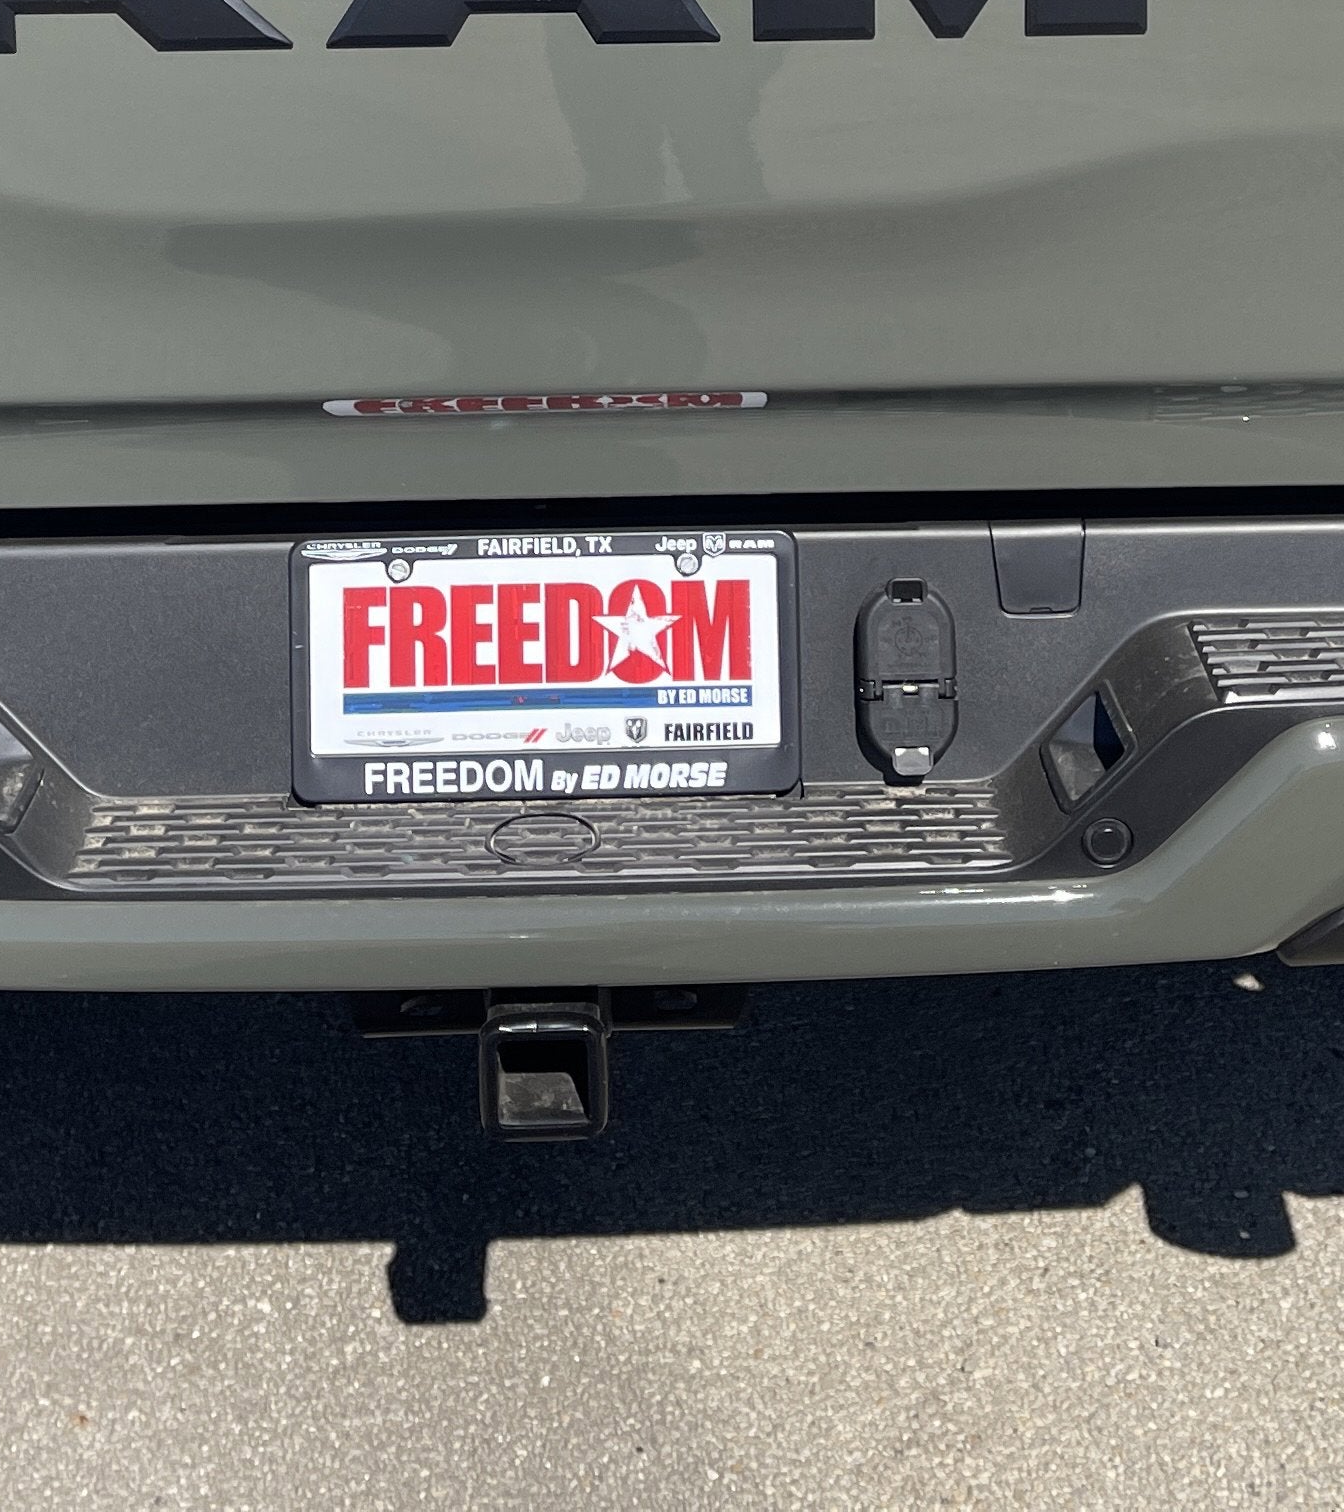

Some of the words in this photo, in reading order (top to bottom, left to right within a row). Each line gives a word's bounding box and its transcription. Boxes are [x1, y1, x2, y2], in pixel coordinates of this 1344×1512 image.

[306, 541, 382, 551] CHRYSLER
[477, 537, 582, 557] FAIRFIELD,
[585, 536, 613, 553] TX
[655, 536, 698, 553] Jeep
[728, 539, 775, 549] RAM
[343, 579, 753, 689] FREEDOM
[658, 689, 676, 705] BY
[679, 689, 697, 704] ED
[699, 688, 748, 704] MORSE
[357, 729, 432, 737] CHRYSLER
[555, 723, 611, 745] Jeep
[664, 721, 754, 742] FAIRFIELD
[364, 759, 544, 795] FREEDOM
[551, 770, 579, 793] By
[581, 765, 620, 790] ED
[624, 762, 728, 788] MORSE
